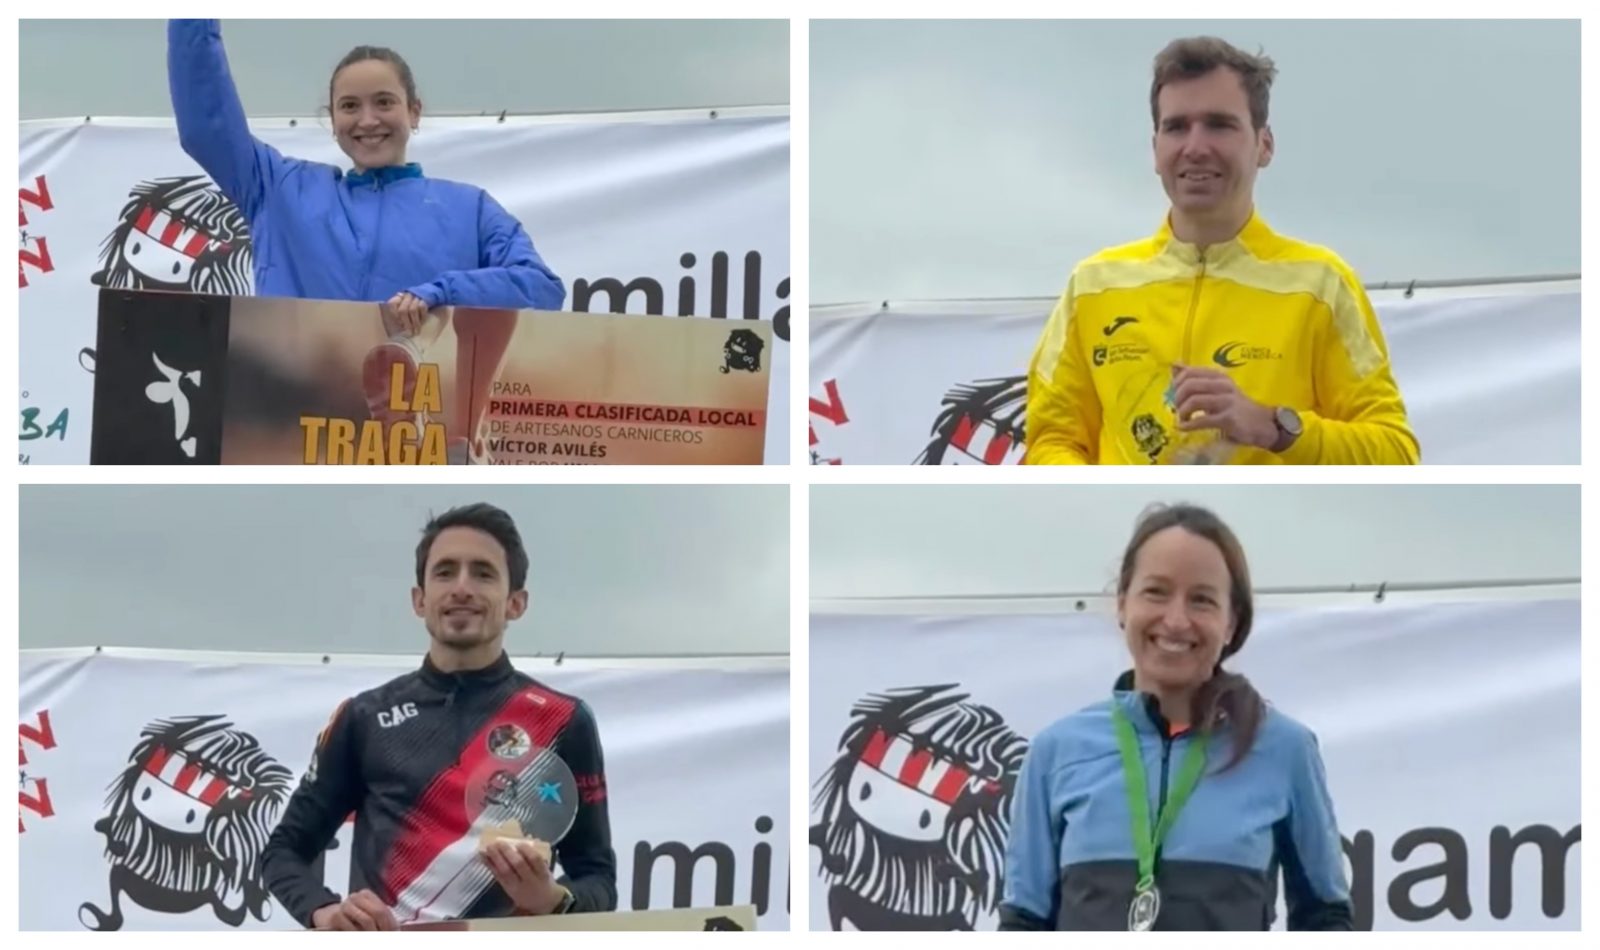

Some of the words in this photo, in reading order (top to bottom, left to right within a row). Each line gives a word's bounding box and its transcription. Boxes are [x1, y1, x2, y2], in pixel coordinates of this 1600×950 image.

[389, 362, 442, 413] LA
[493, 381, 532, 396] PARA
[489, 400, 569, 418] PRIMERA
[575, 403, 692, 423] CLASIFICADA
[698, 410, 757, 426] LOCAL
[299, 416, 449, 465] TRAGA
[490, 419, 510, 434] DE
[514, 421, 602, 439] ARTESANOS
[607, 425, 703, 444] CARNICEROS
[489, 436, 547, 455] VÍCTOR
[552, 441, 607, 458] AVILÉS
[377, 701, 419, 728] CAG
